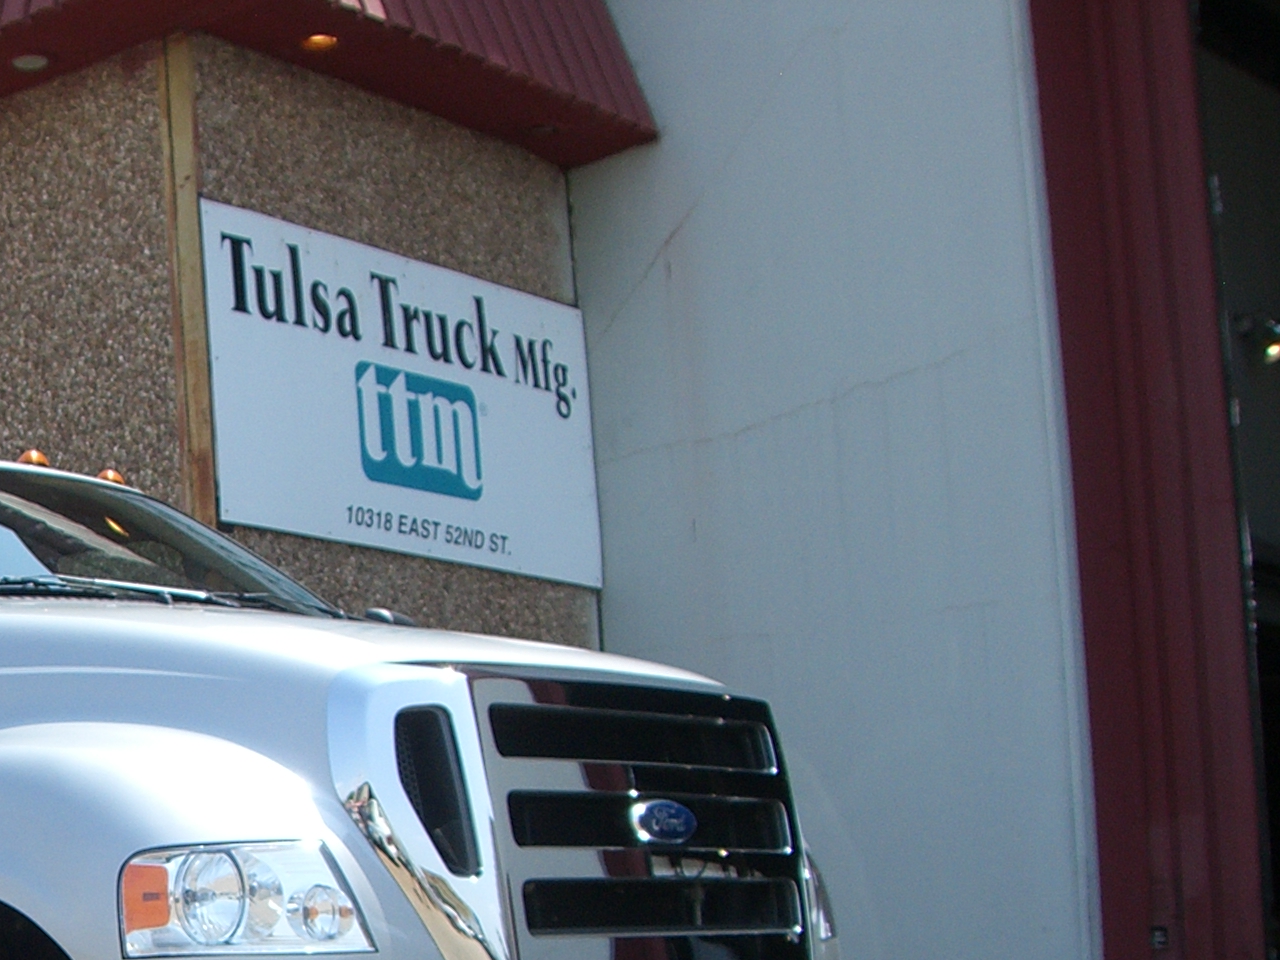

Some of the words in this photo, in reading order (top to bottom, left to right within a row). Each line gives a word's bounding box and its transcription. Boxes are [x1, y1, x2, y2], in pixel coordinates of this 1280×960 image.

[220, 231, 363, 341] Tulsa
[370, 270, 507, 377] Truck
[513, 332, 577, 419] Mfg.
[346, 504, 393, 531] 10318
[398, 514, 441, 540] EAST
[445, 524, 485, 550] 52ND
[489, 532, 512, 555] ST.
[651, 806, 687, 832] Ford
